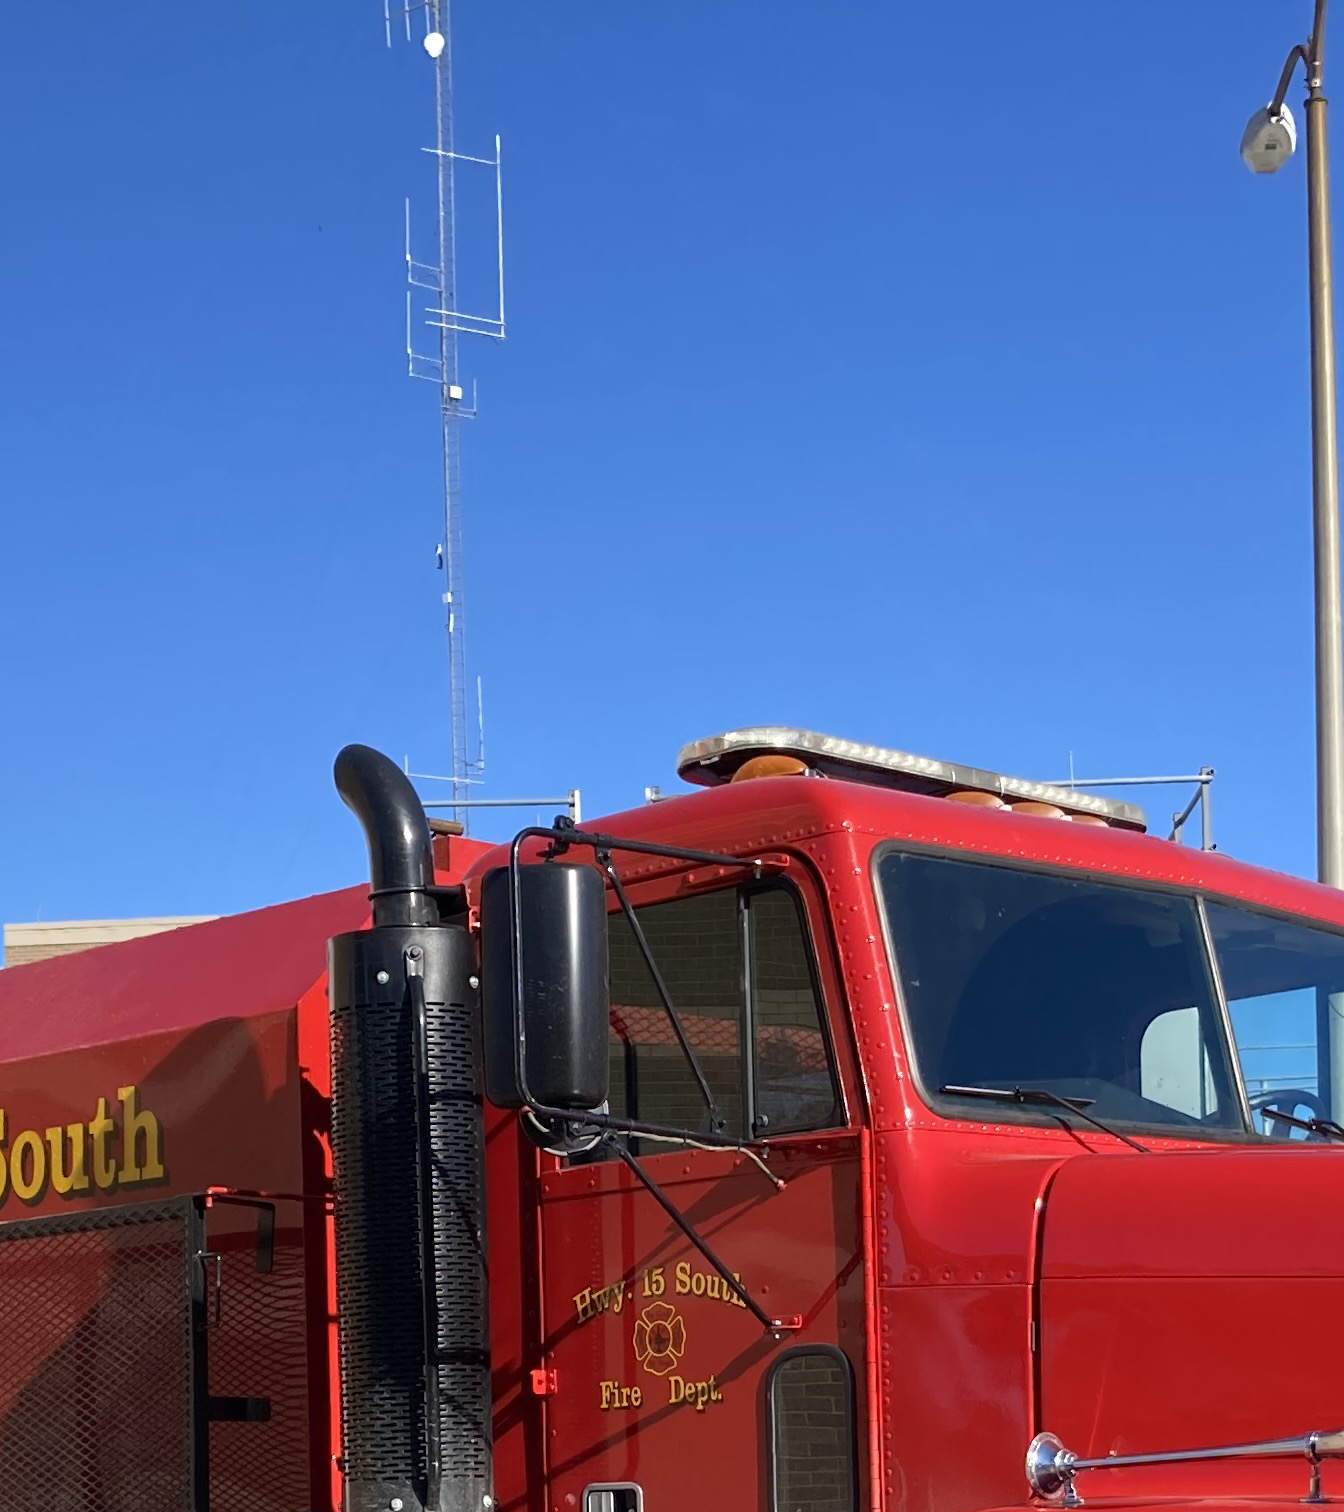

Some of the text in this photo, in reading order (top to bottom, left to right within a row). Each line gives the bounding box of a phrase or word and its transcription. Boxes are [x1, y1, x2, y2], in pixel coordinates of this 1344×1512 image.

[641, 1267, 666, 1297] 15
[599, 1374, 724, 1411] Fire Dept.
